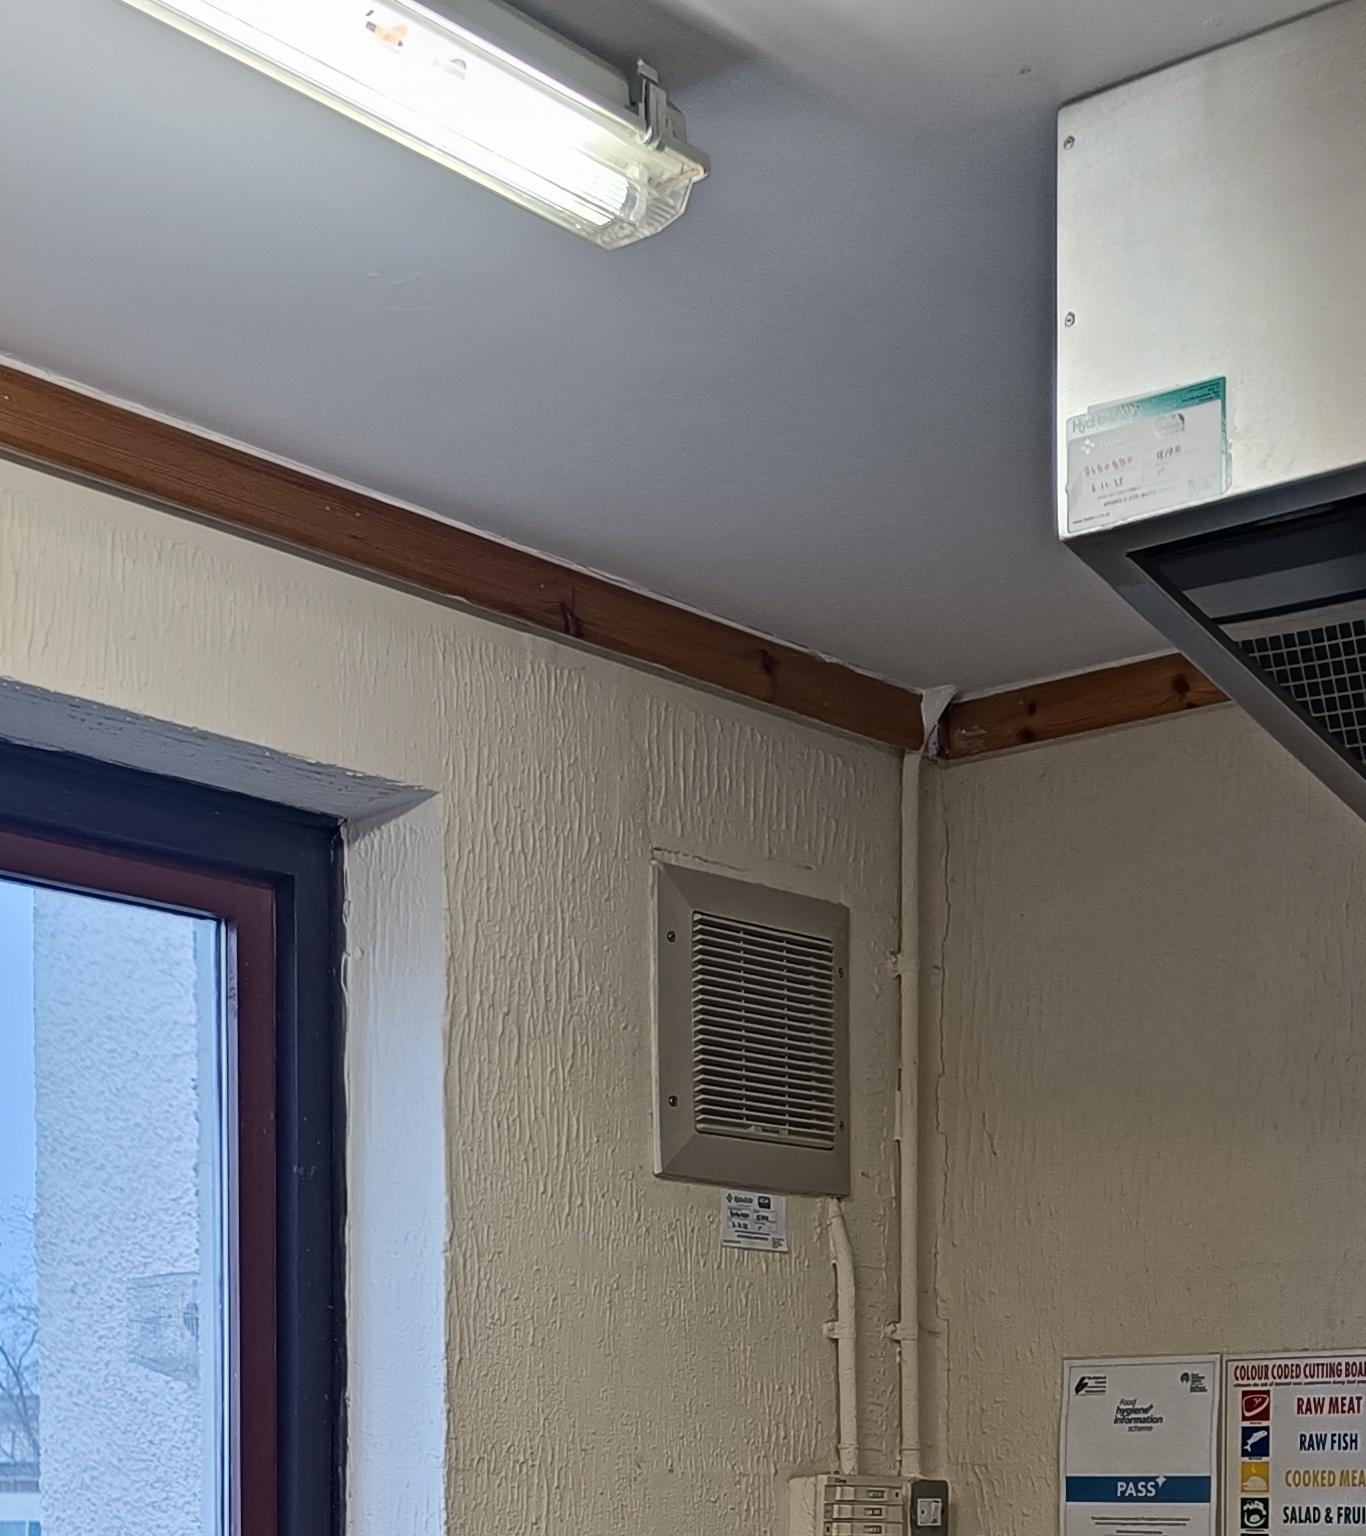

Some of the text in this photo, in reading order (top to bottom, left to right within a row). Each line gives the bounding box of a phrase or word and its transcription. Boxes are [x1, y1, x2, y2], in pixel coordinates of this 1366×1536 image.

[1234, 1365, 1269, 1381] COLOUR
[1271, 1363, 1301, 1380] CODED
[1302, 1361, 1343, 1379] CUTTING
[1296, 1396, 1363, 1415] RAW MEAT
[1113, 1415, 1163, 1425] information
[1299, 1433, 1358, 1451] RAW FISH
[1285, 1470, 1335, 1488] COOKED
[1116, 1481, 1156, 1497] PASS
[1283, 1507, 1321, 1524] SALAD
[1323, 1507, 1333, 1524] &
